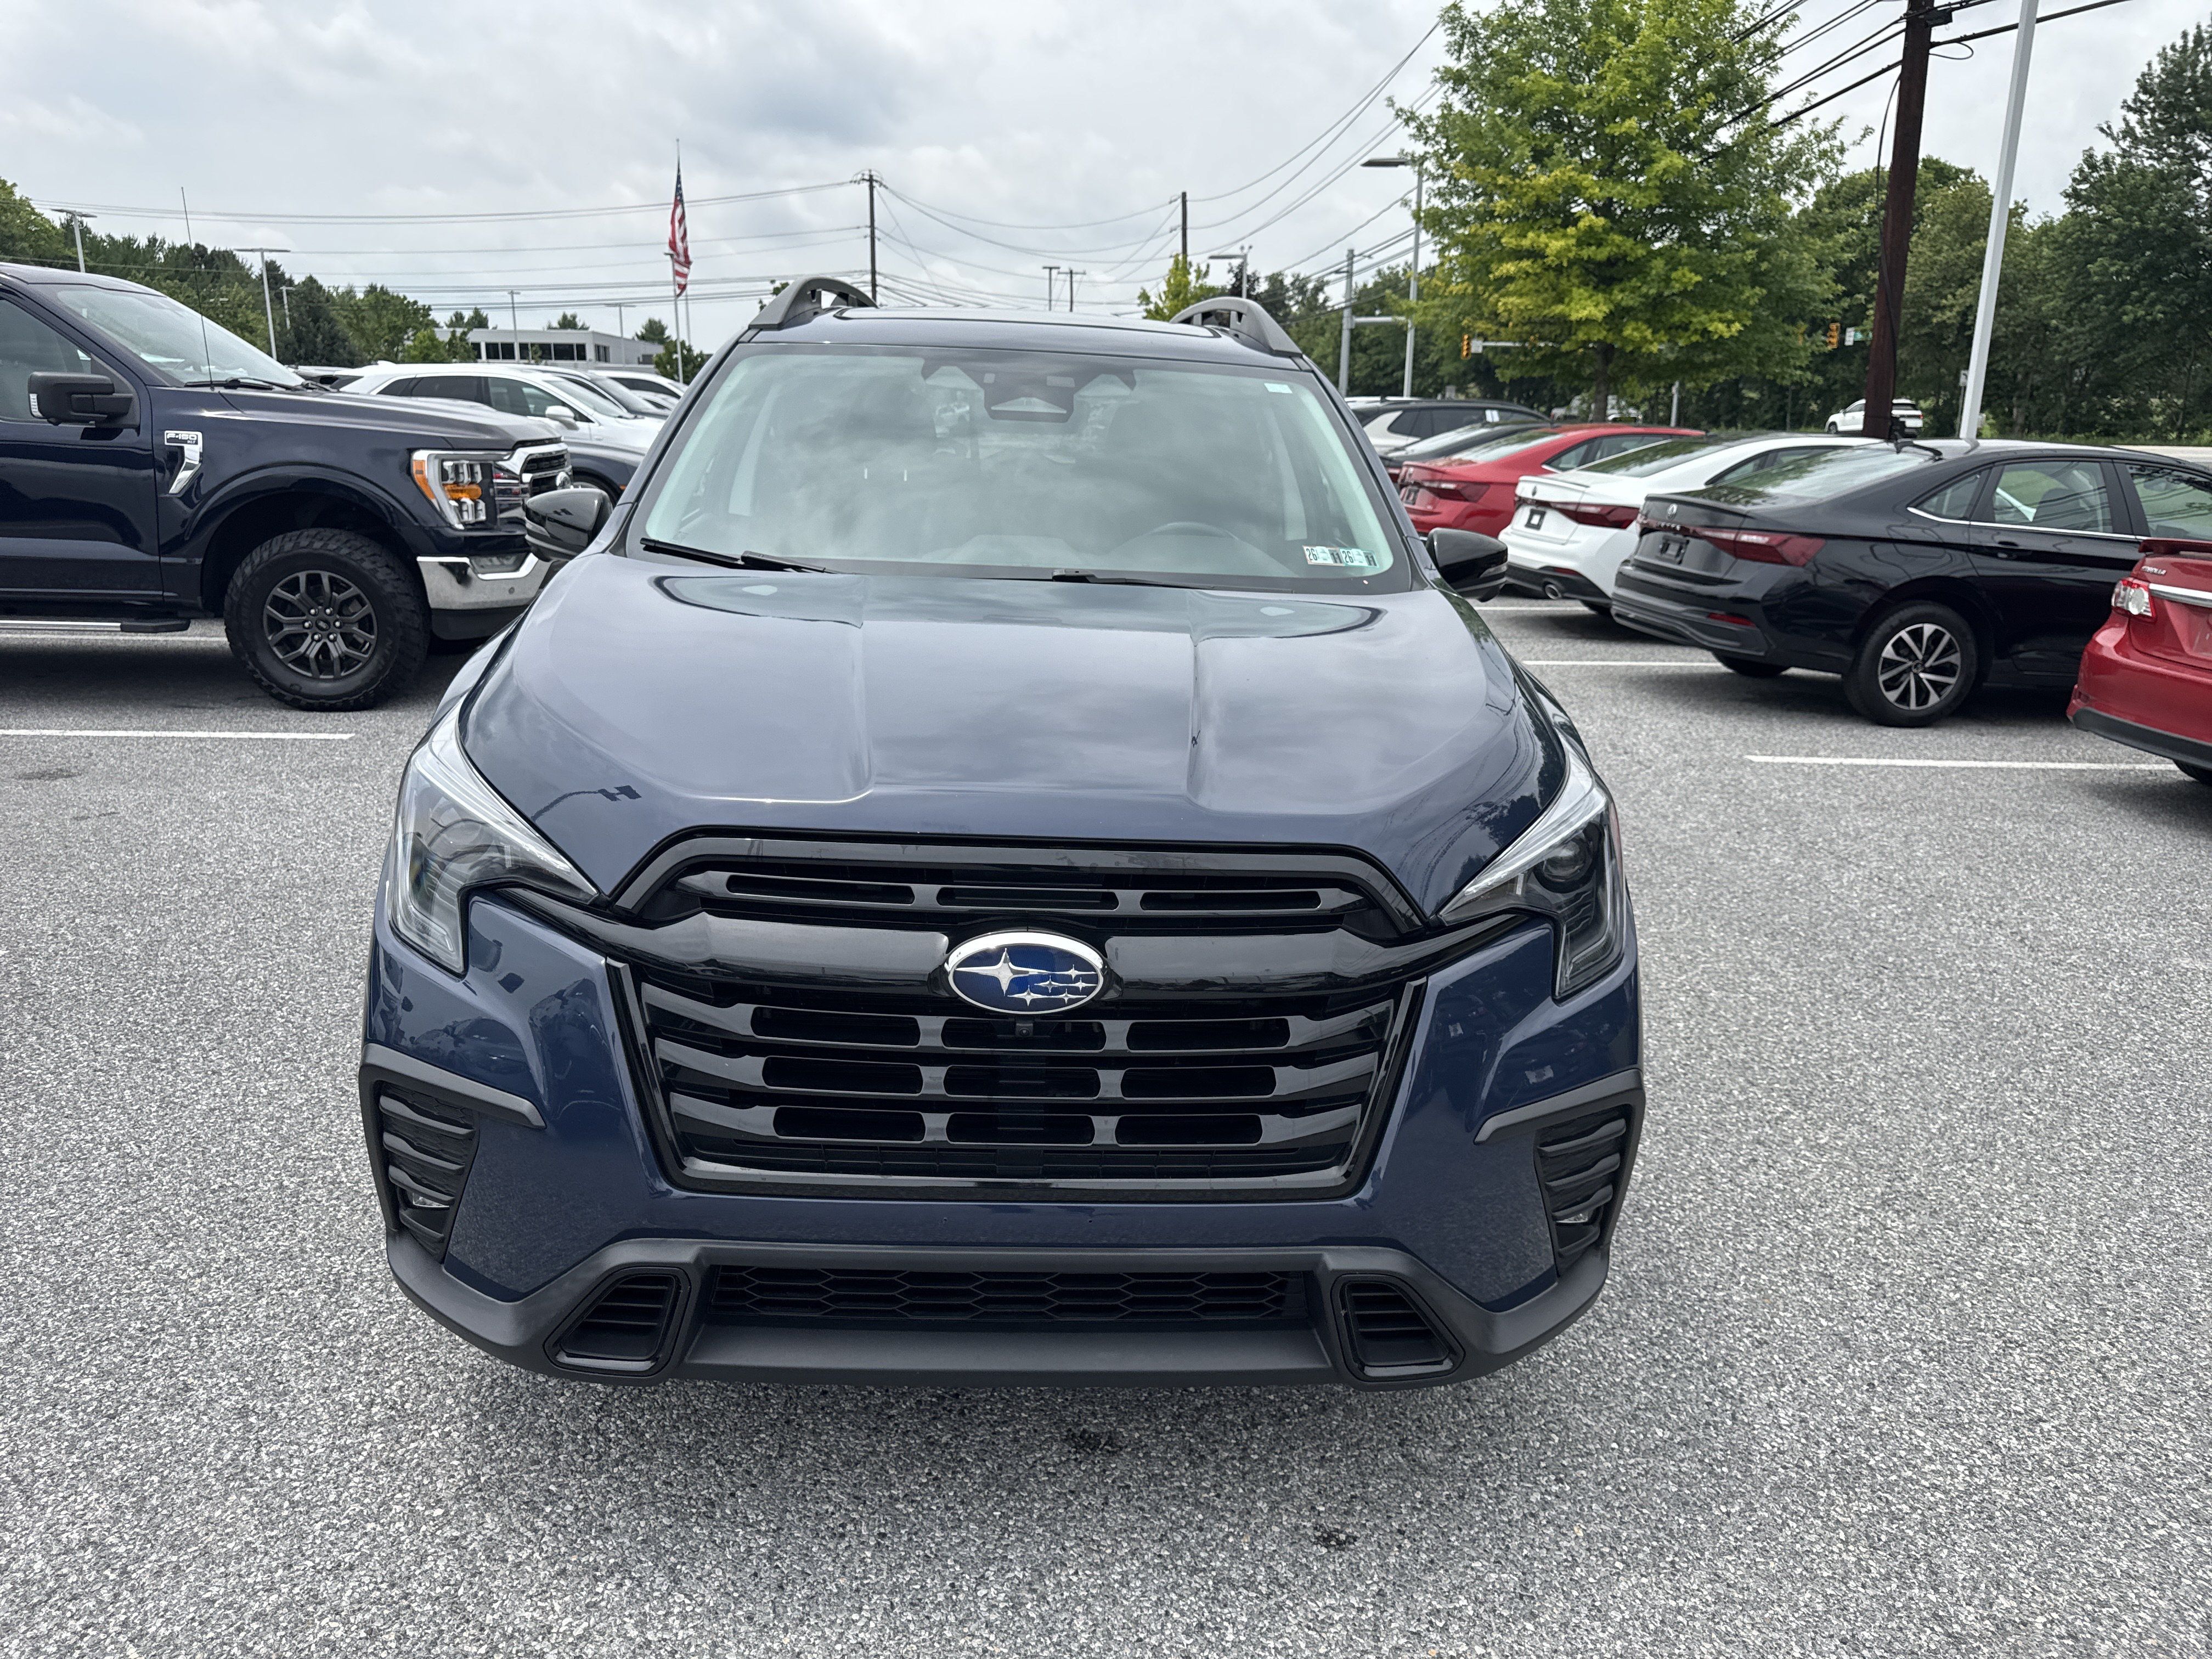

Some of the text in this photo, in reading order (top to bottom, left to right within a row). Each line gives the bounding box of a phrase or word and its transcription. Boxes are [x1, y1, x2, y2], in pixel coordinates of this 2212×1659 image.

[1306, 549, 1342, 563] 26 11
[1342, 551, 1376, 566] 26 11
